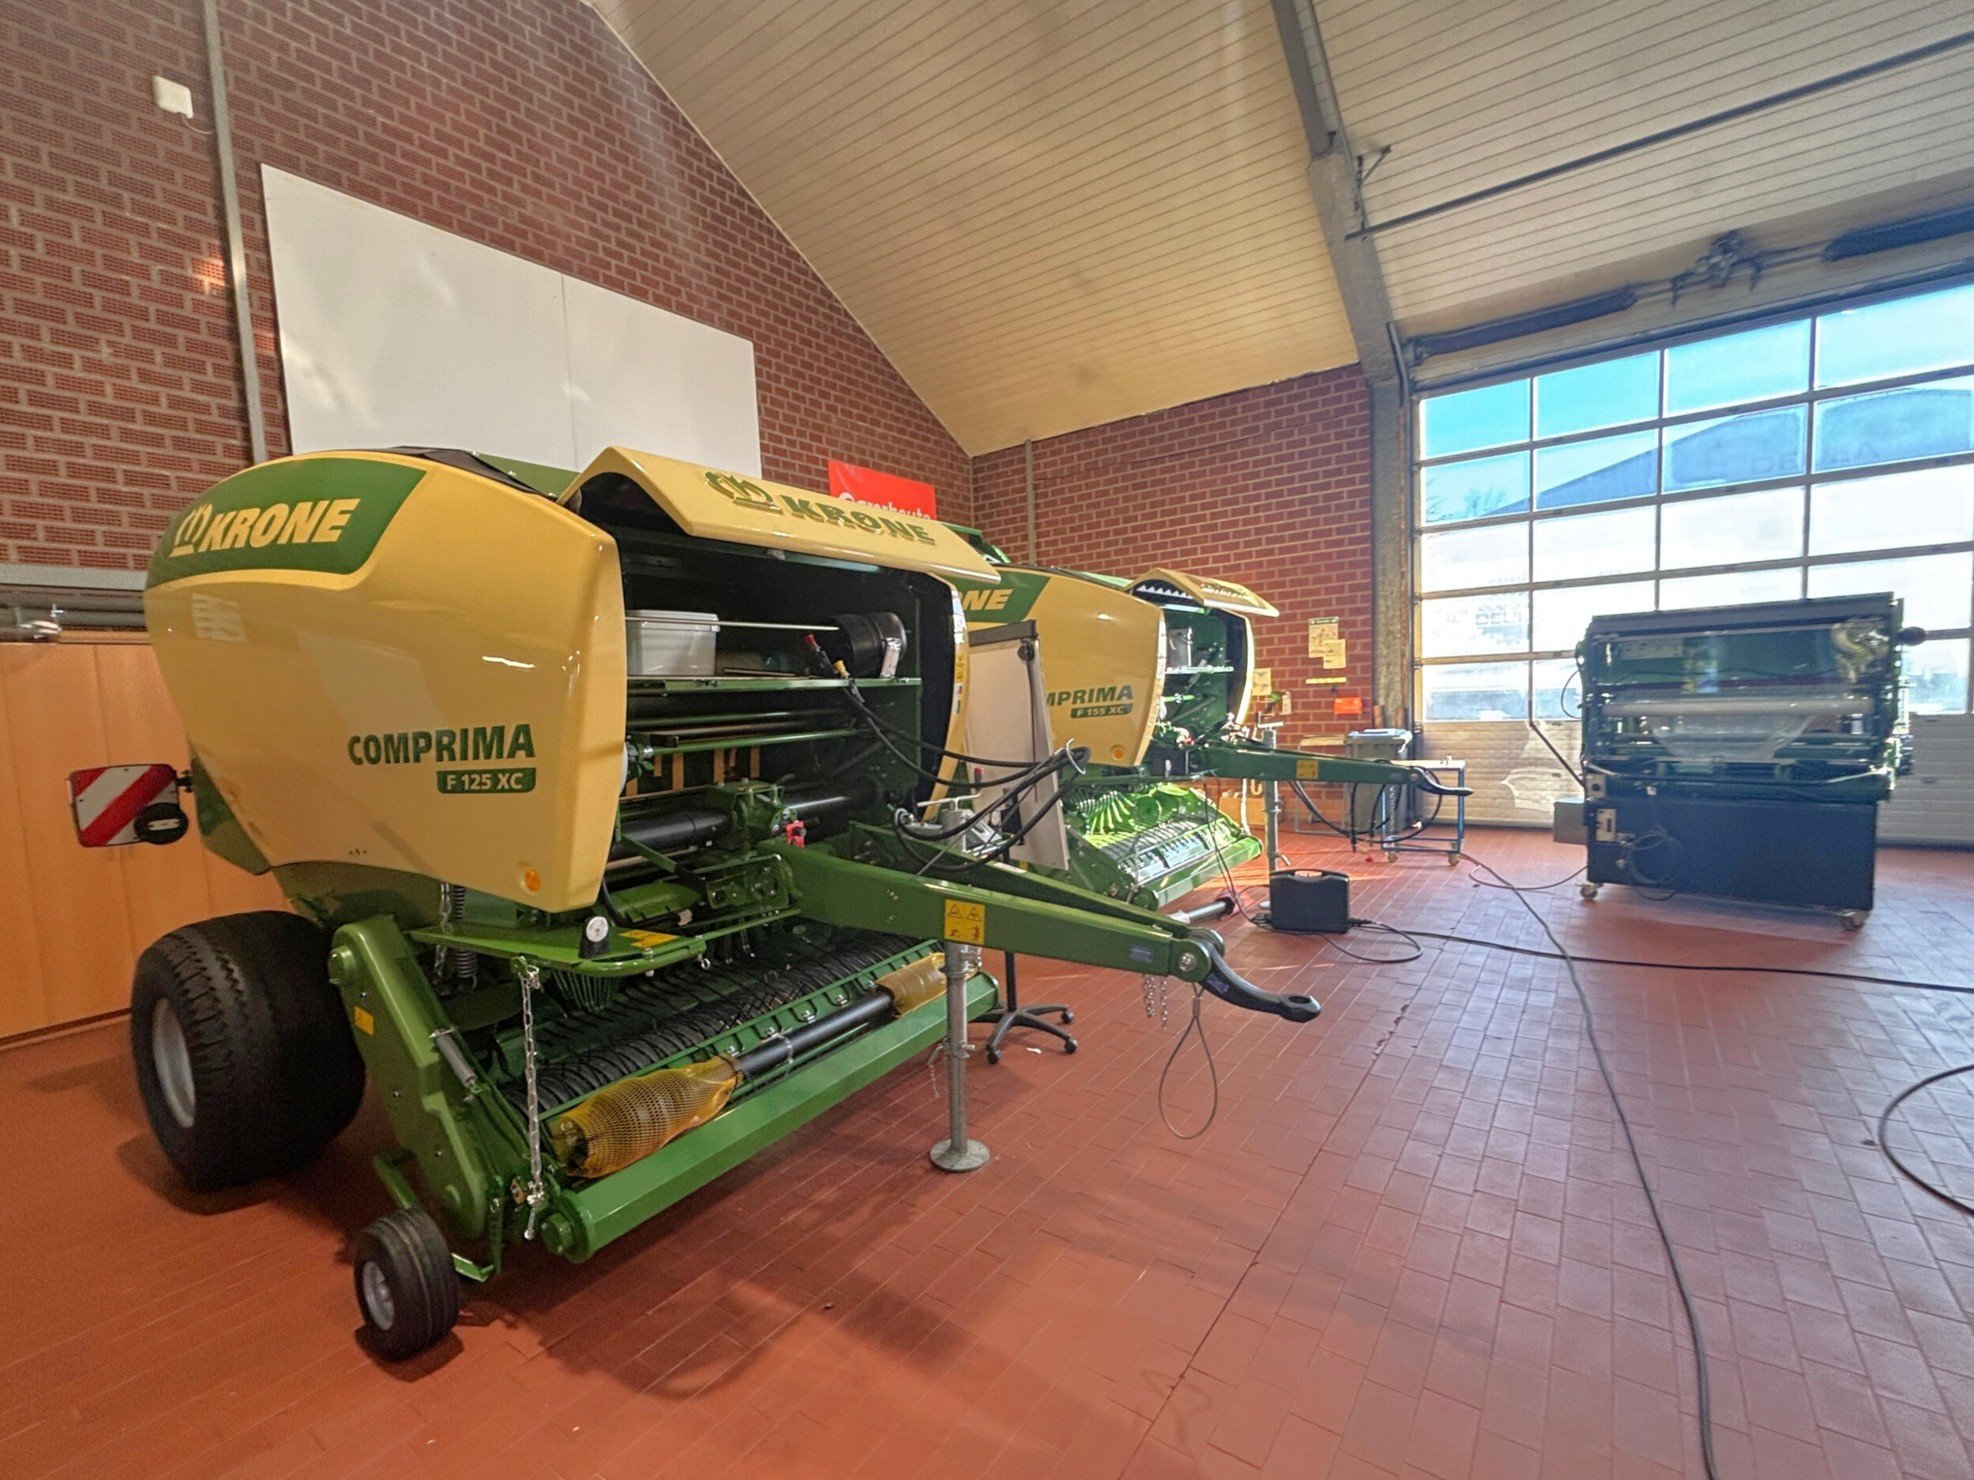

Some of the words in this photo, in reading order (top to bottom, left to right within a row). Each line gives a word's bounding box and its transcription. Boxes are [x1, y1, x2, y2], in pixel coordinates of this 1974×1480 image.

[197, 498, 361, 552] KRONE
[779, 494, 936, 546] KRONE
[959, 589, 1014, 611] NE
[1076, 709, 1083, 717] F
[1087, 707, 1106, 717] 155
[1108, 706, 1125, 714] XC
[347, 723, 536, 766] COMPRIMA
[446, 774, 457, 790] F
[461, 773, 492, 790] 125
[496, 772, 524, 790] XC
